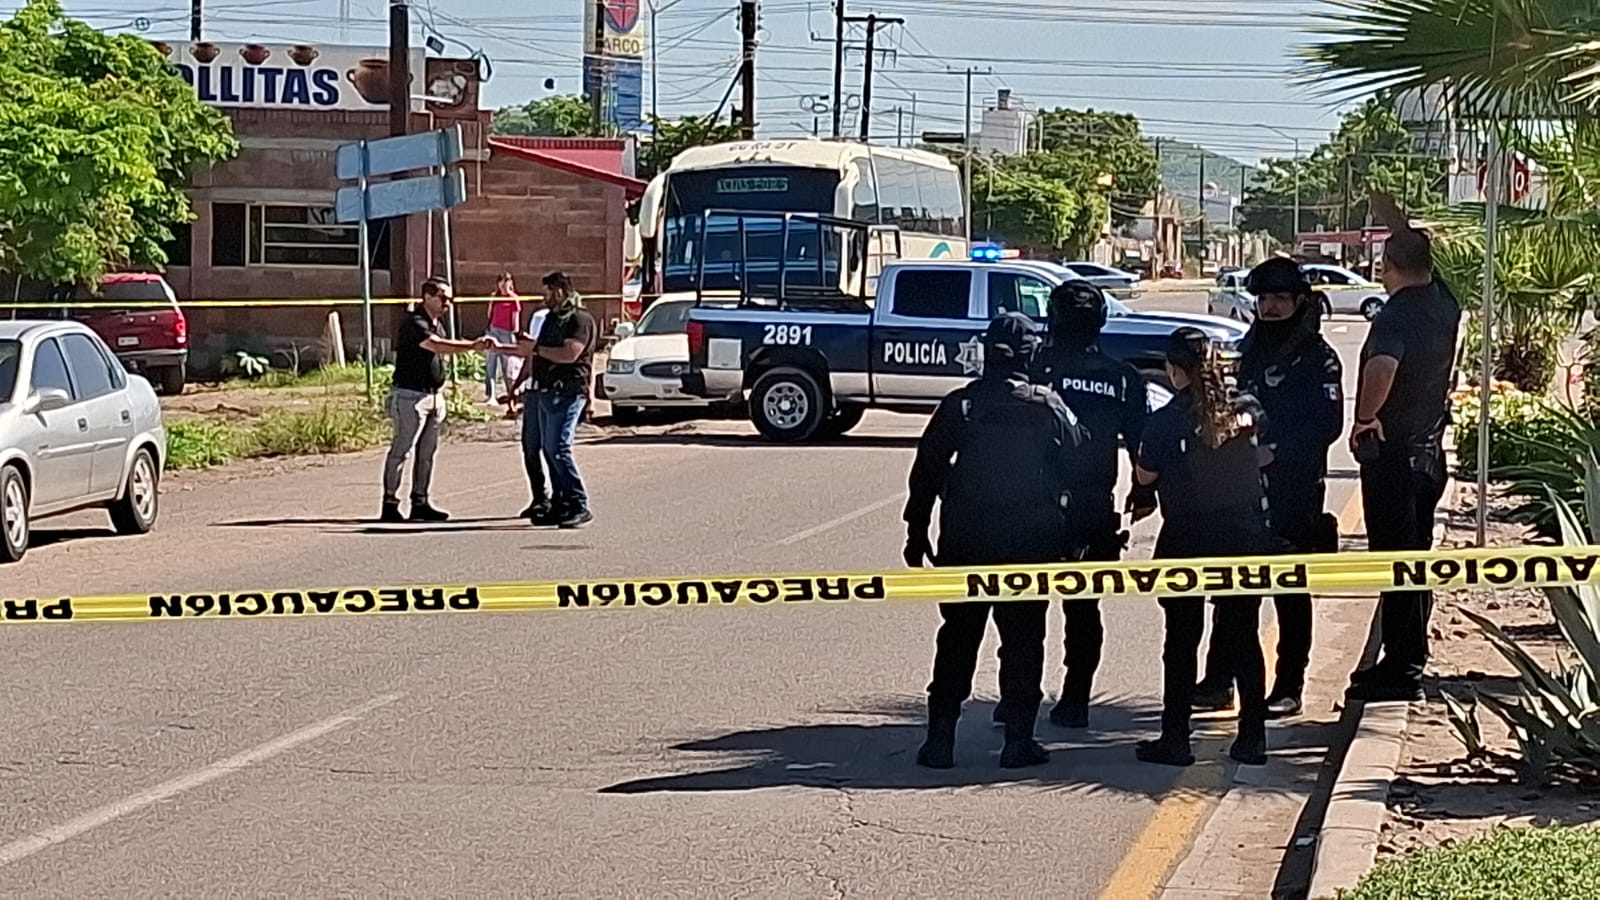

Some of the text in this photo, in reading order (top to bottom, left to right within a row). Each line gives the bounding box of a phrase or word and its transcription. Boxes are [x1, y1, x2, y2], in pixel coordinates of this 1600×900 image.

[604, 38, 641, 54] ARCO
[763, 324, 812, 346] 2891
[884, 338, 947, 366] POLICÍA
[1062, 378, 1116, 398] POLICÍA
[149, 587, 479, 617] PRECAUCIÓN
[556, 576, 885, 608] PRECAUCIÓN
[966, 563, 1308, 597] PRECAUCIÓN
